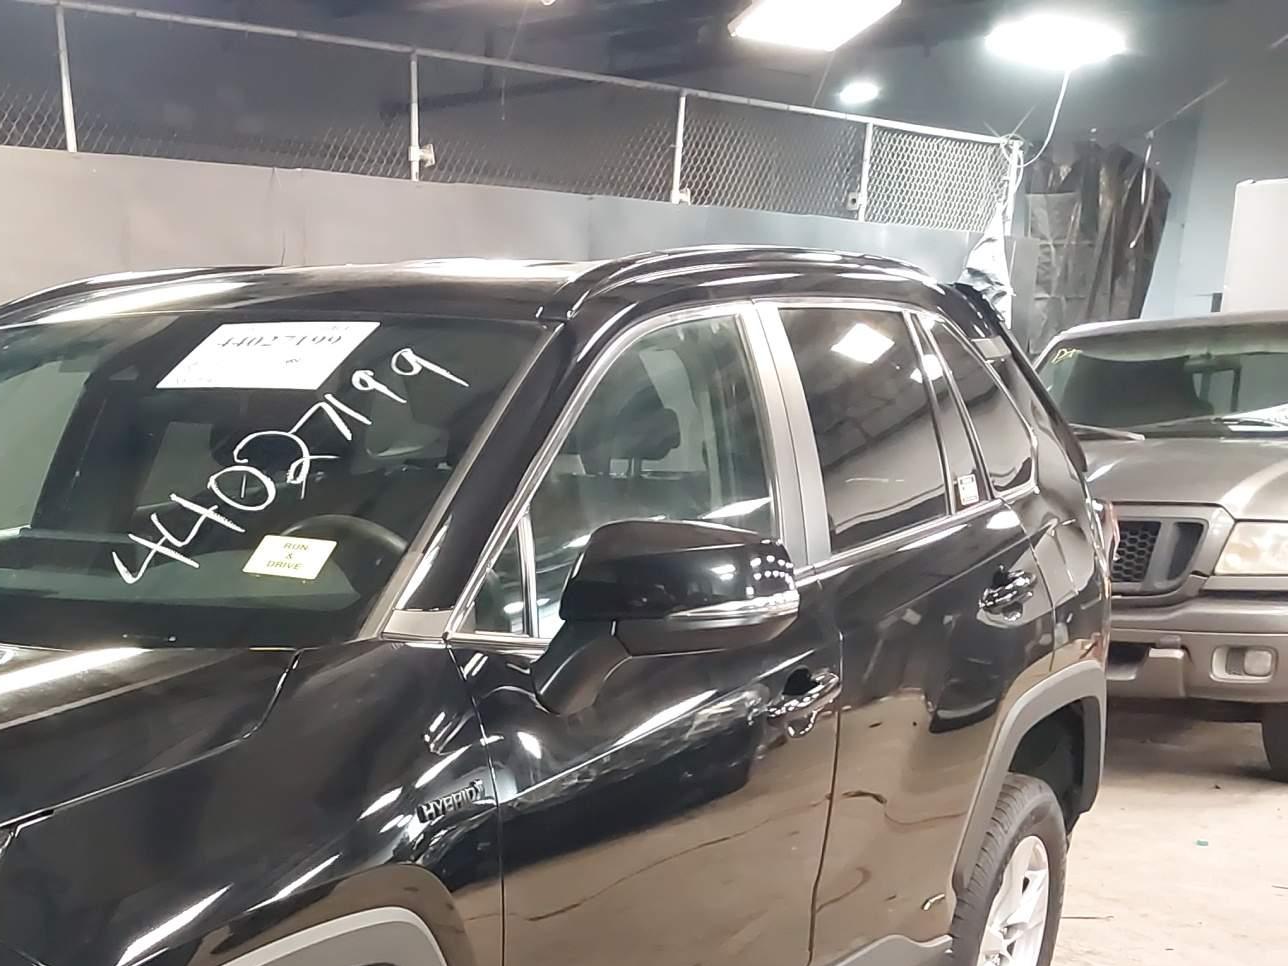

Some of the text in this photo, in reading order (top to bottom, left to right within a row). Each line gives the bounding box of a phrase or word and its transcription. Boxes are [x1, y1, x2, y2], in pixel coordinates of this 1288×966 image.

[112, 347, 470, 585] 44027199
[283, 542, 309, 551] RUN
[266, 560, 303, 570] DRIVE
[420, 785, 480, 822] HYBRID
